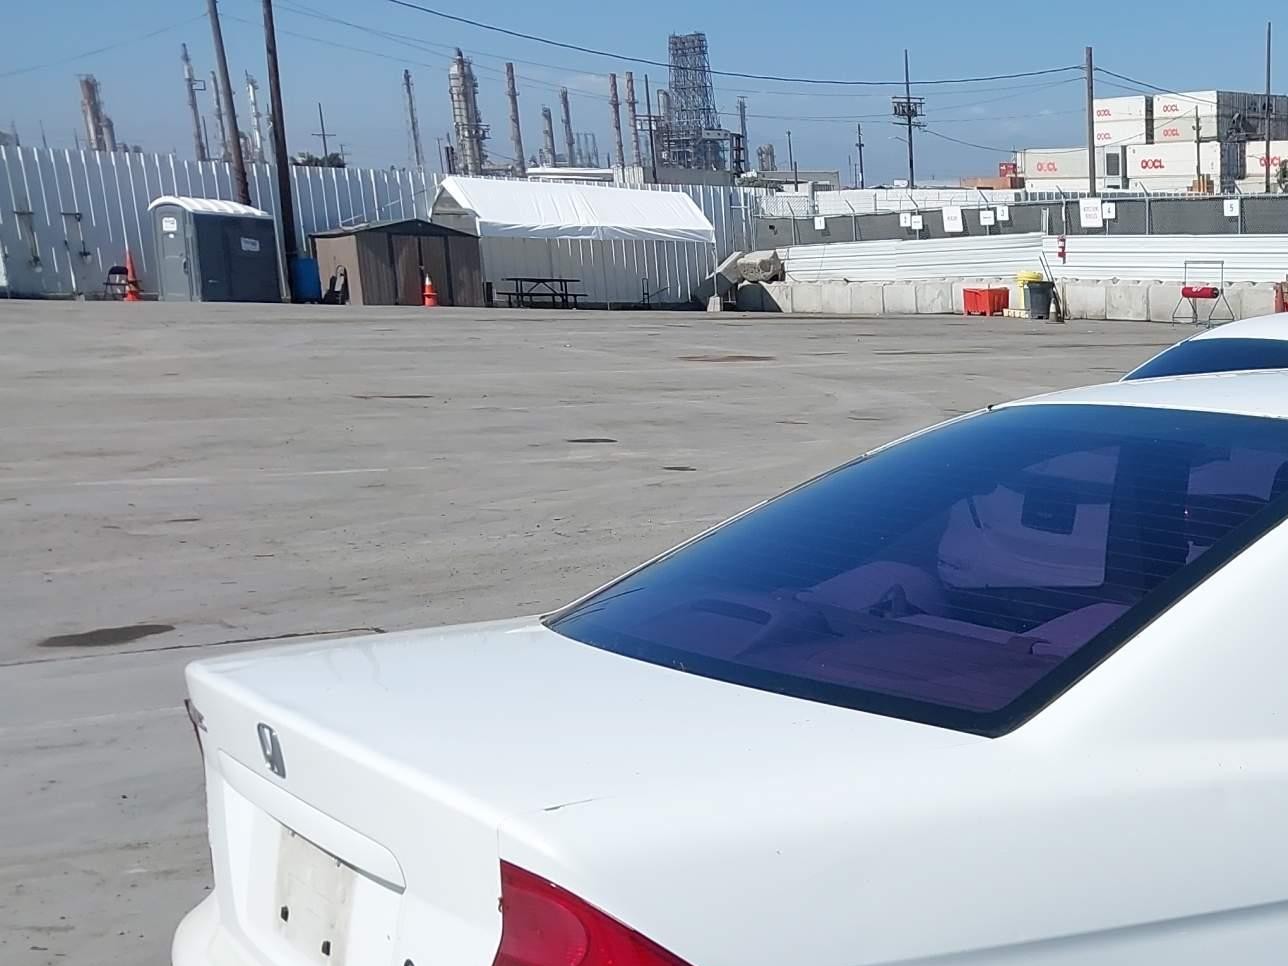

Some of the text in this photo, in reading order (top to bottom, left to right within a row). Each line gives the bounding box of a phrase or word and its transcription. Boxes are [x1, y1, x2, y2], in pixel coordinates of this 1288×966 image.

[1163, 104, 1180, 112] OOCL
[1097, 109, 1112, 117] OOCL
[1163, 128, 1180, 137] OOCL
[1141, 159, 1165, 169] OOCL
[1229, 203, 1234, 212] 5
